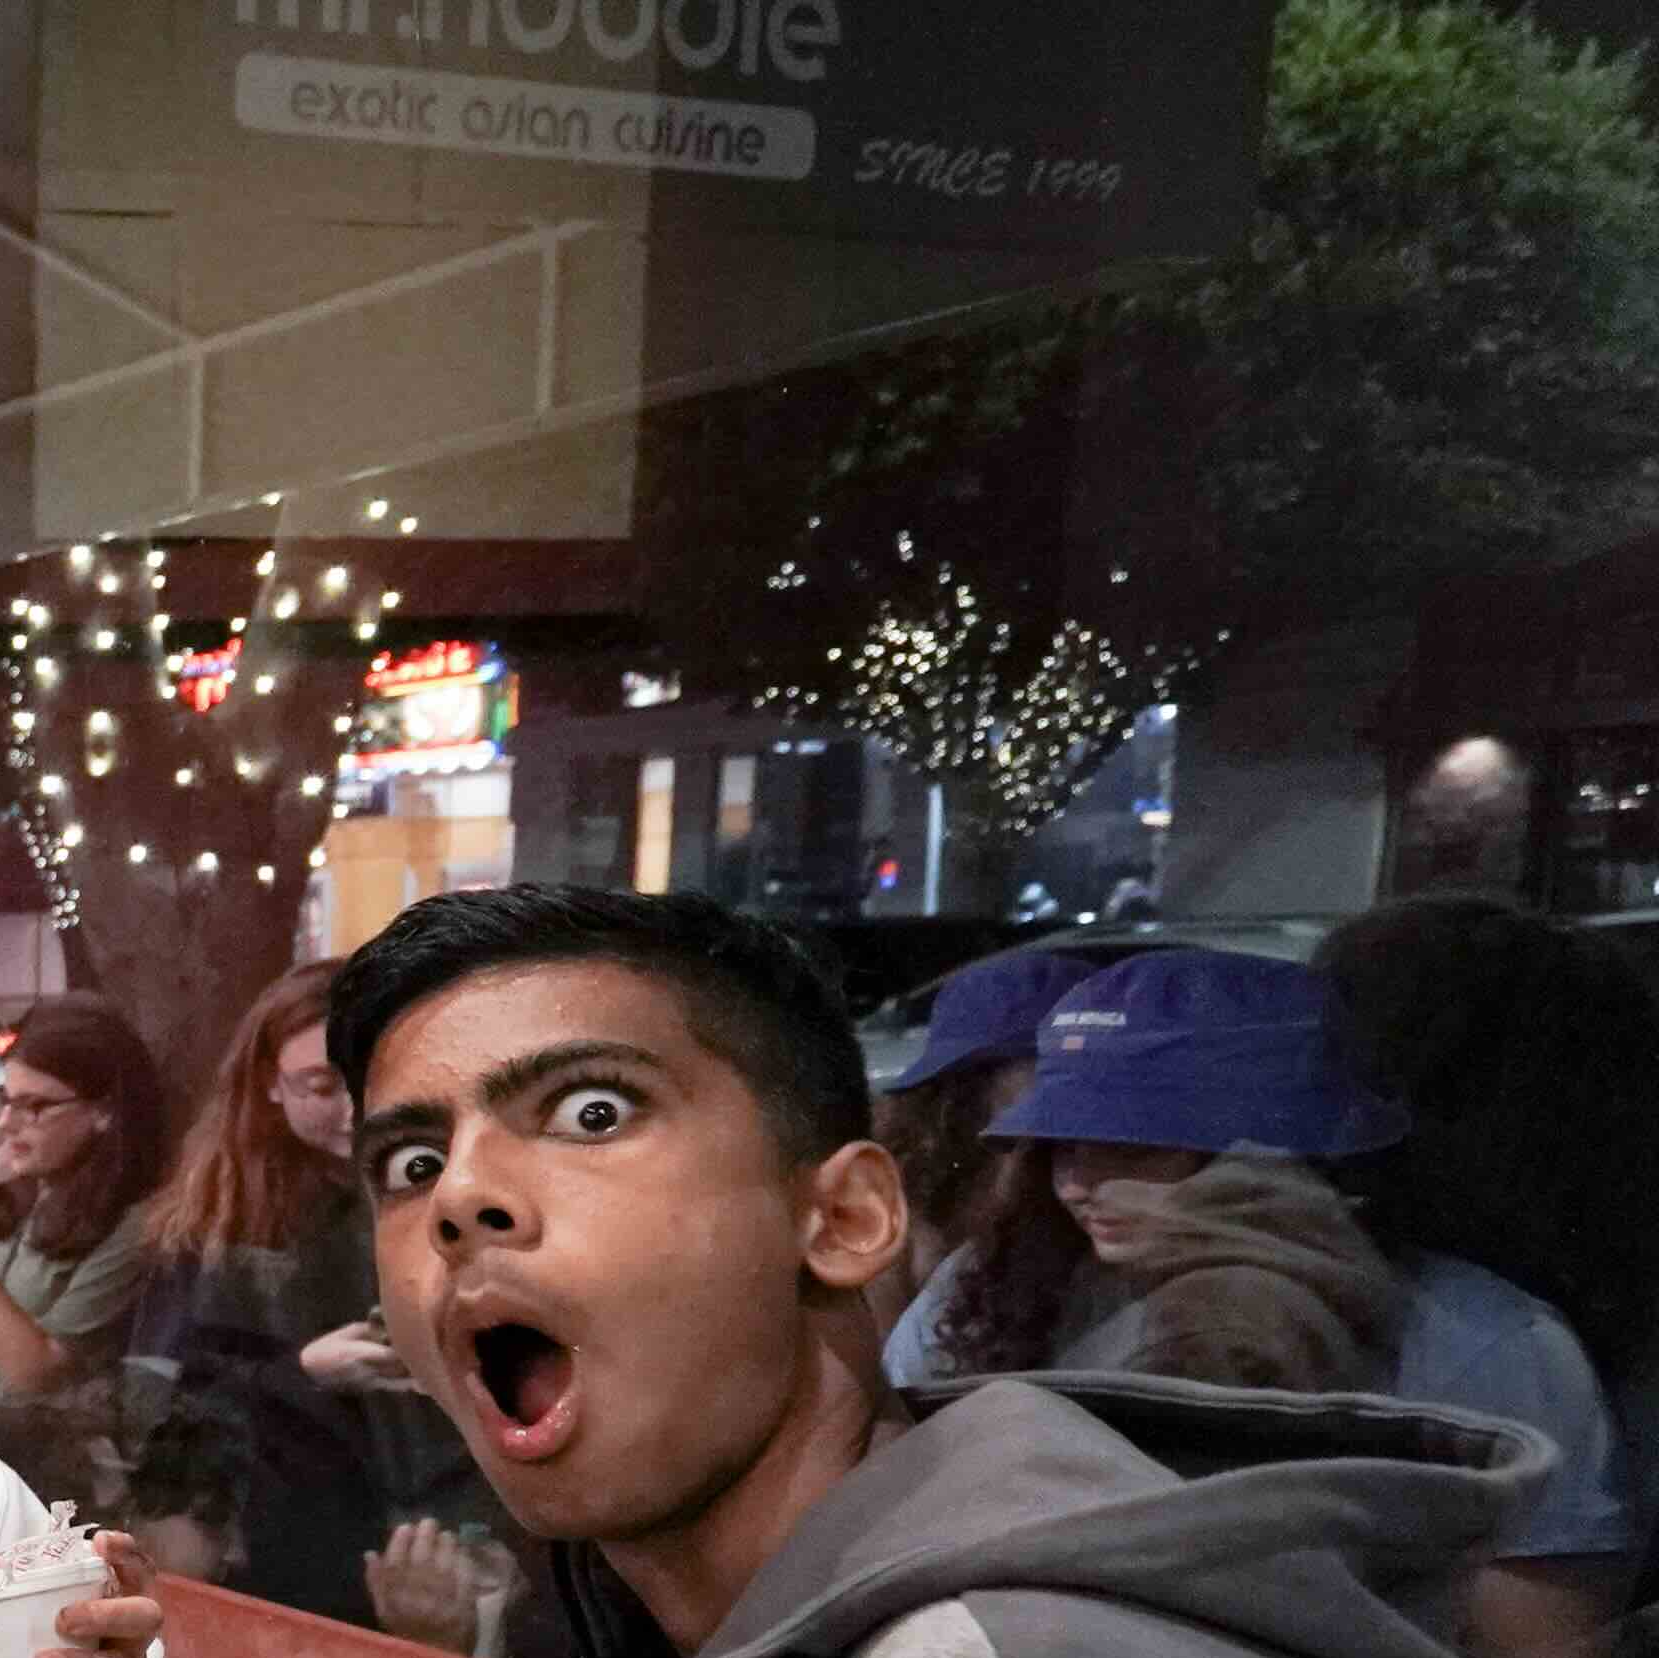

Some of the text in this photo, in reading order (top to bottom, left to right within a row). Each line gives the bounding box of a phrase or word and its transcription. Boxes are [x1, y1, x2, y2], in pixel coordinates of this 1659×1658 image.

[290, 80, 766, 166] exotic asian cuisine
[854, 139, 1012, 195] SINCE
